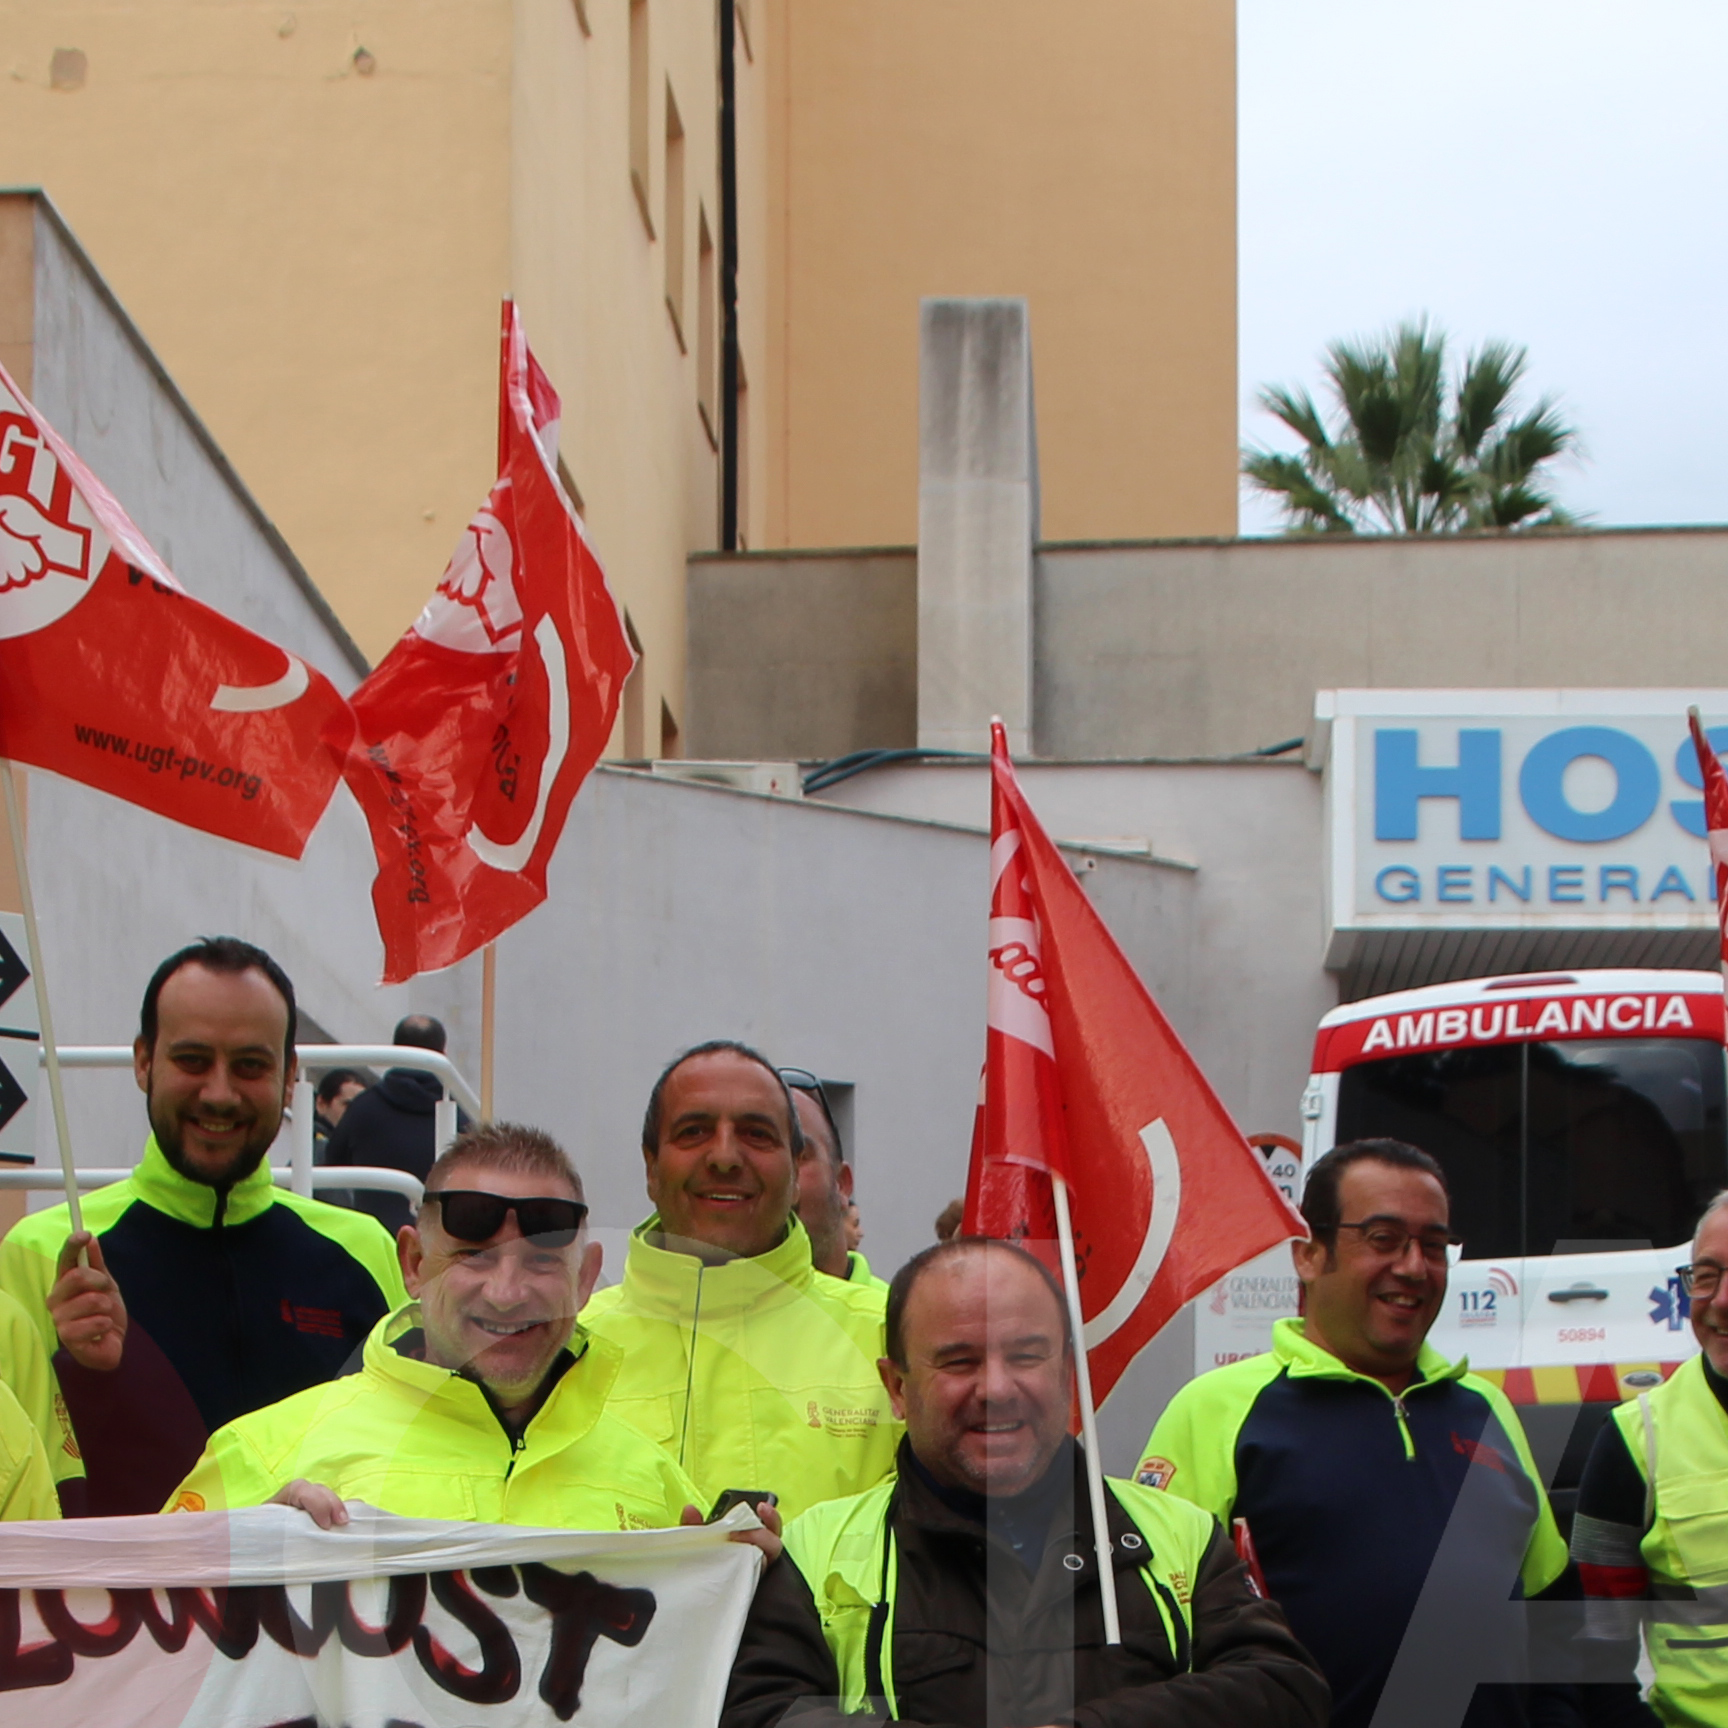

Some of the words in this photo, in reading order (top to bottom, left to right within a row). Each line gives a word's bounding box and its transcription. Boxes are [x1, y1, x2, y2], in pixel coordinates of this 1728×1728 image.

[73, 722, 262, 799] www.ugt-pv.org
[1375, 863, 1718, 902] GENERA
[1362, 995, 1693, 1053] AMBULANCIA
[1460, 1290, 1496, 1311] 112
[1558, 1327, 1606, 1343] 50894
